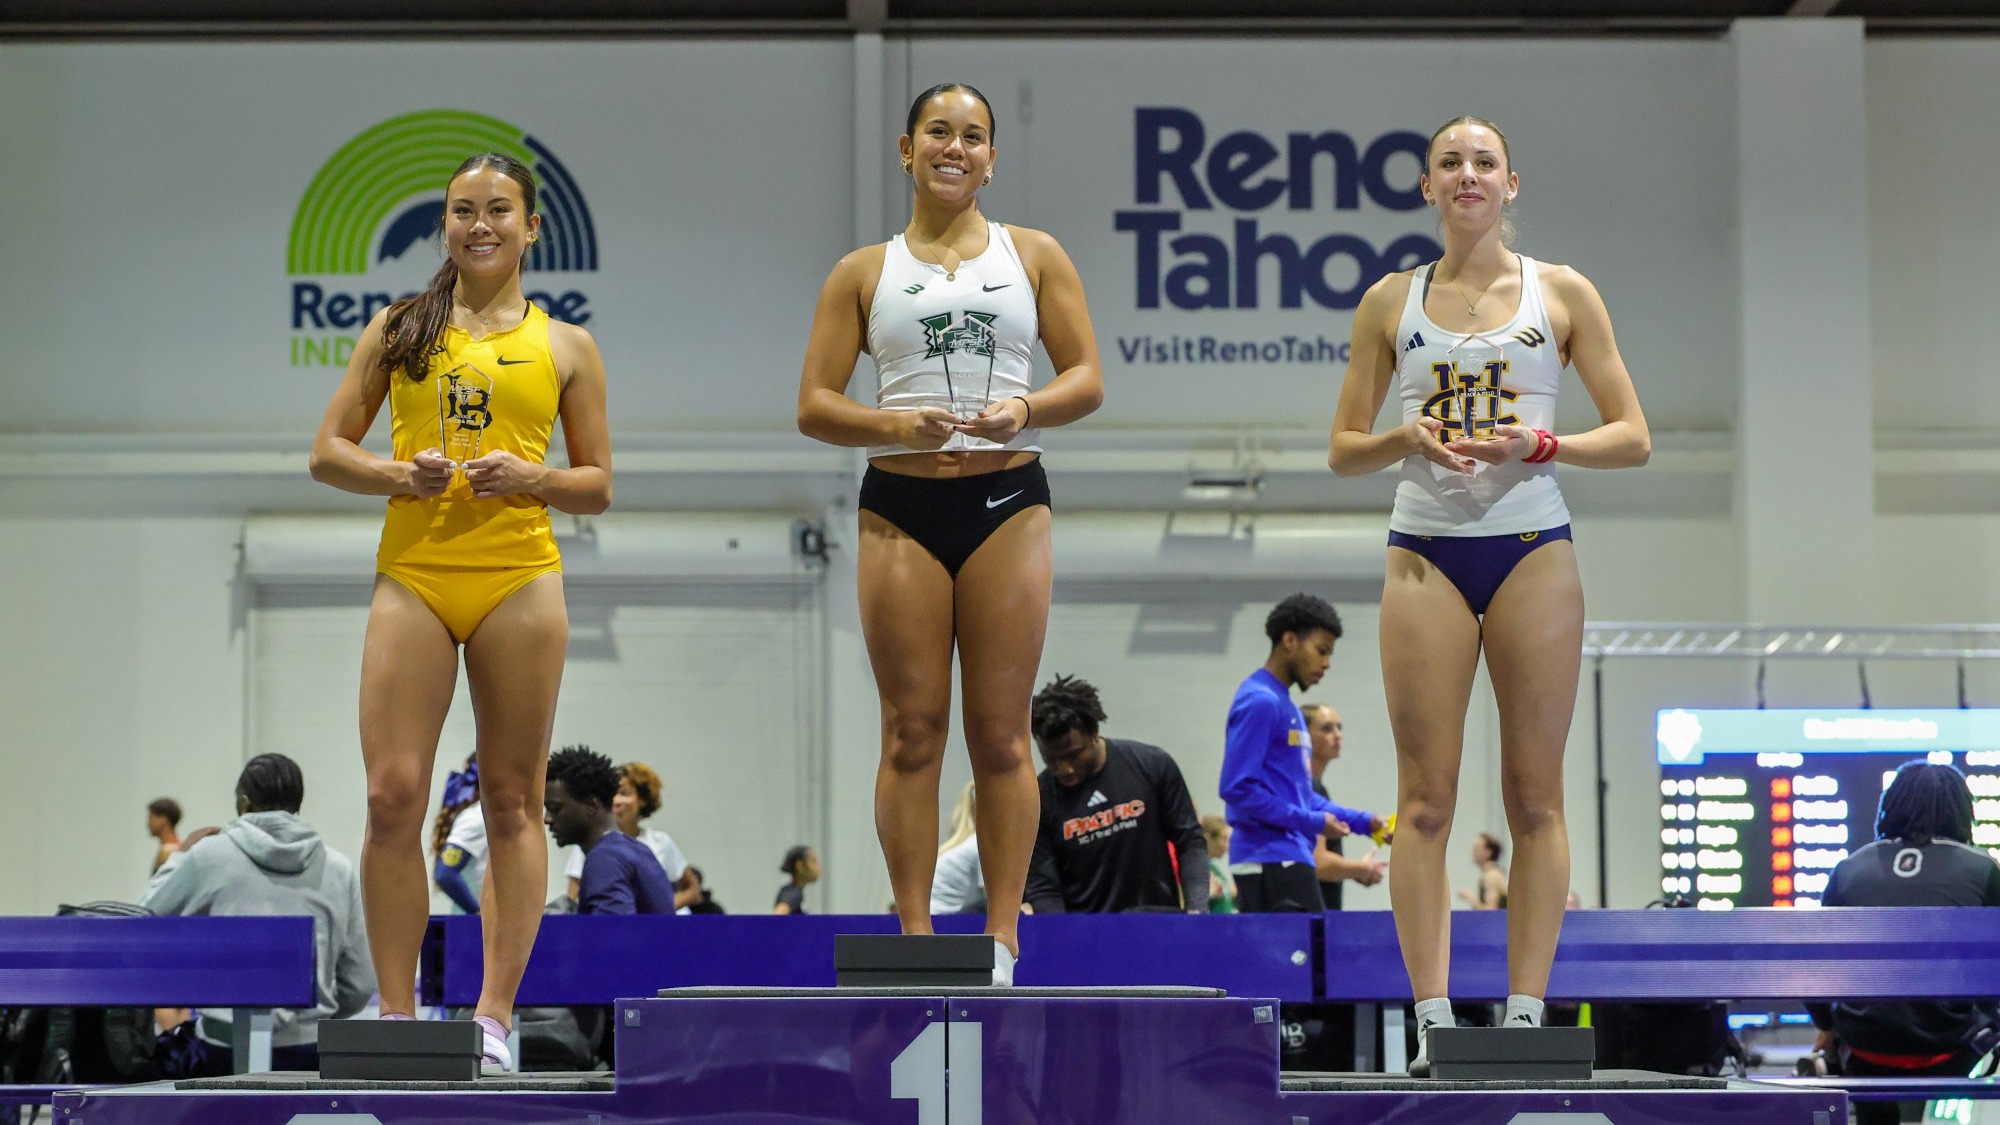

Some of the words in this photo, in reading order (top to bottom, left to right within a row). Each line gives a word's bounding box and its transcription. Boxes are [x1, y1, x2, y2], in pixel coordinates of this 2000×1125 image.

[1134, 107, 1431, 211] Reno
[292, 282, 420, 330] Ren
[291, 336, 355, 367] IND
[1117, 336, 1351, 363] VisitRenoTaho
[1063, 799, 1146, 840] PACIFIC
[891, 1022, 982, 1125] 1
